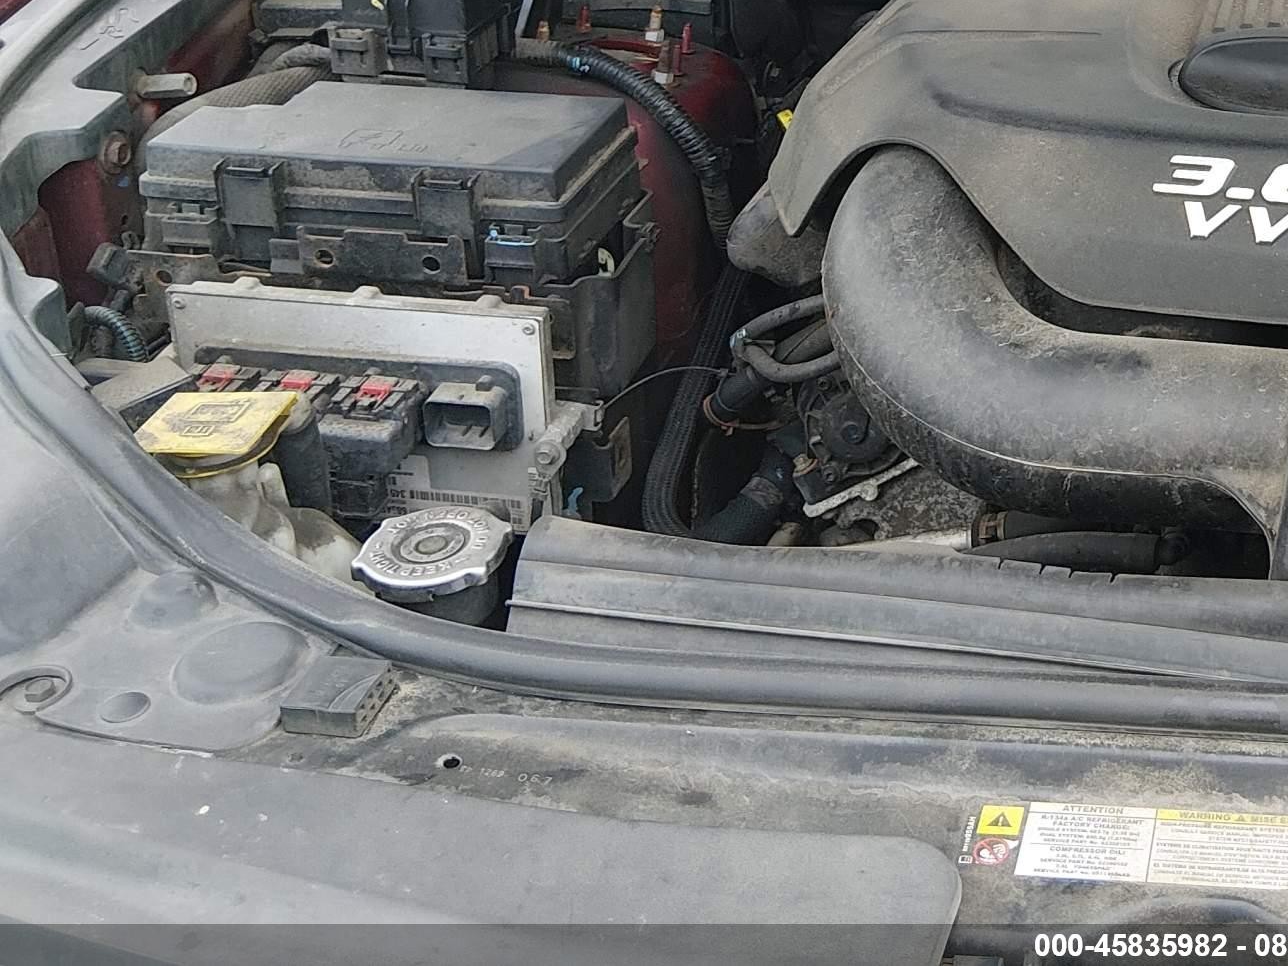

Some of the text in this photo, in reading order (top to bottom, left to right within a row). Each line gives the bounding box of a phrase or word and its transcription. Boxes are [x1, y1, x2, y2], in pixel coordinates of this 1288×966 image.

[399, 564, 453, 578] KEEP
[1062, 805, 1123, 814] ATTENTION
[1086, 816, 1144, 824] REFRIGERANT
[1179, 811, 1231, 820] WARNING
[1250, 815, 1276, 823] MISE
